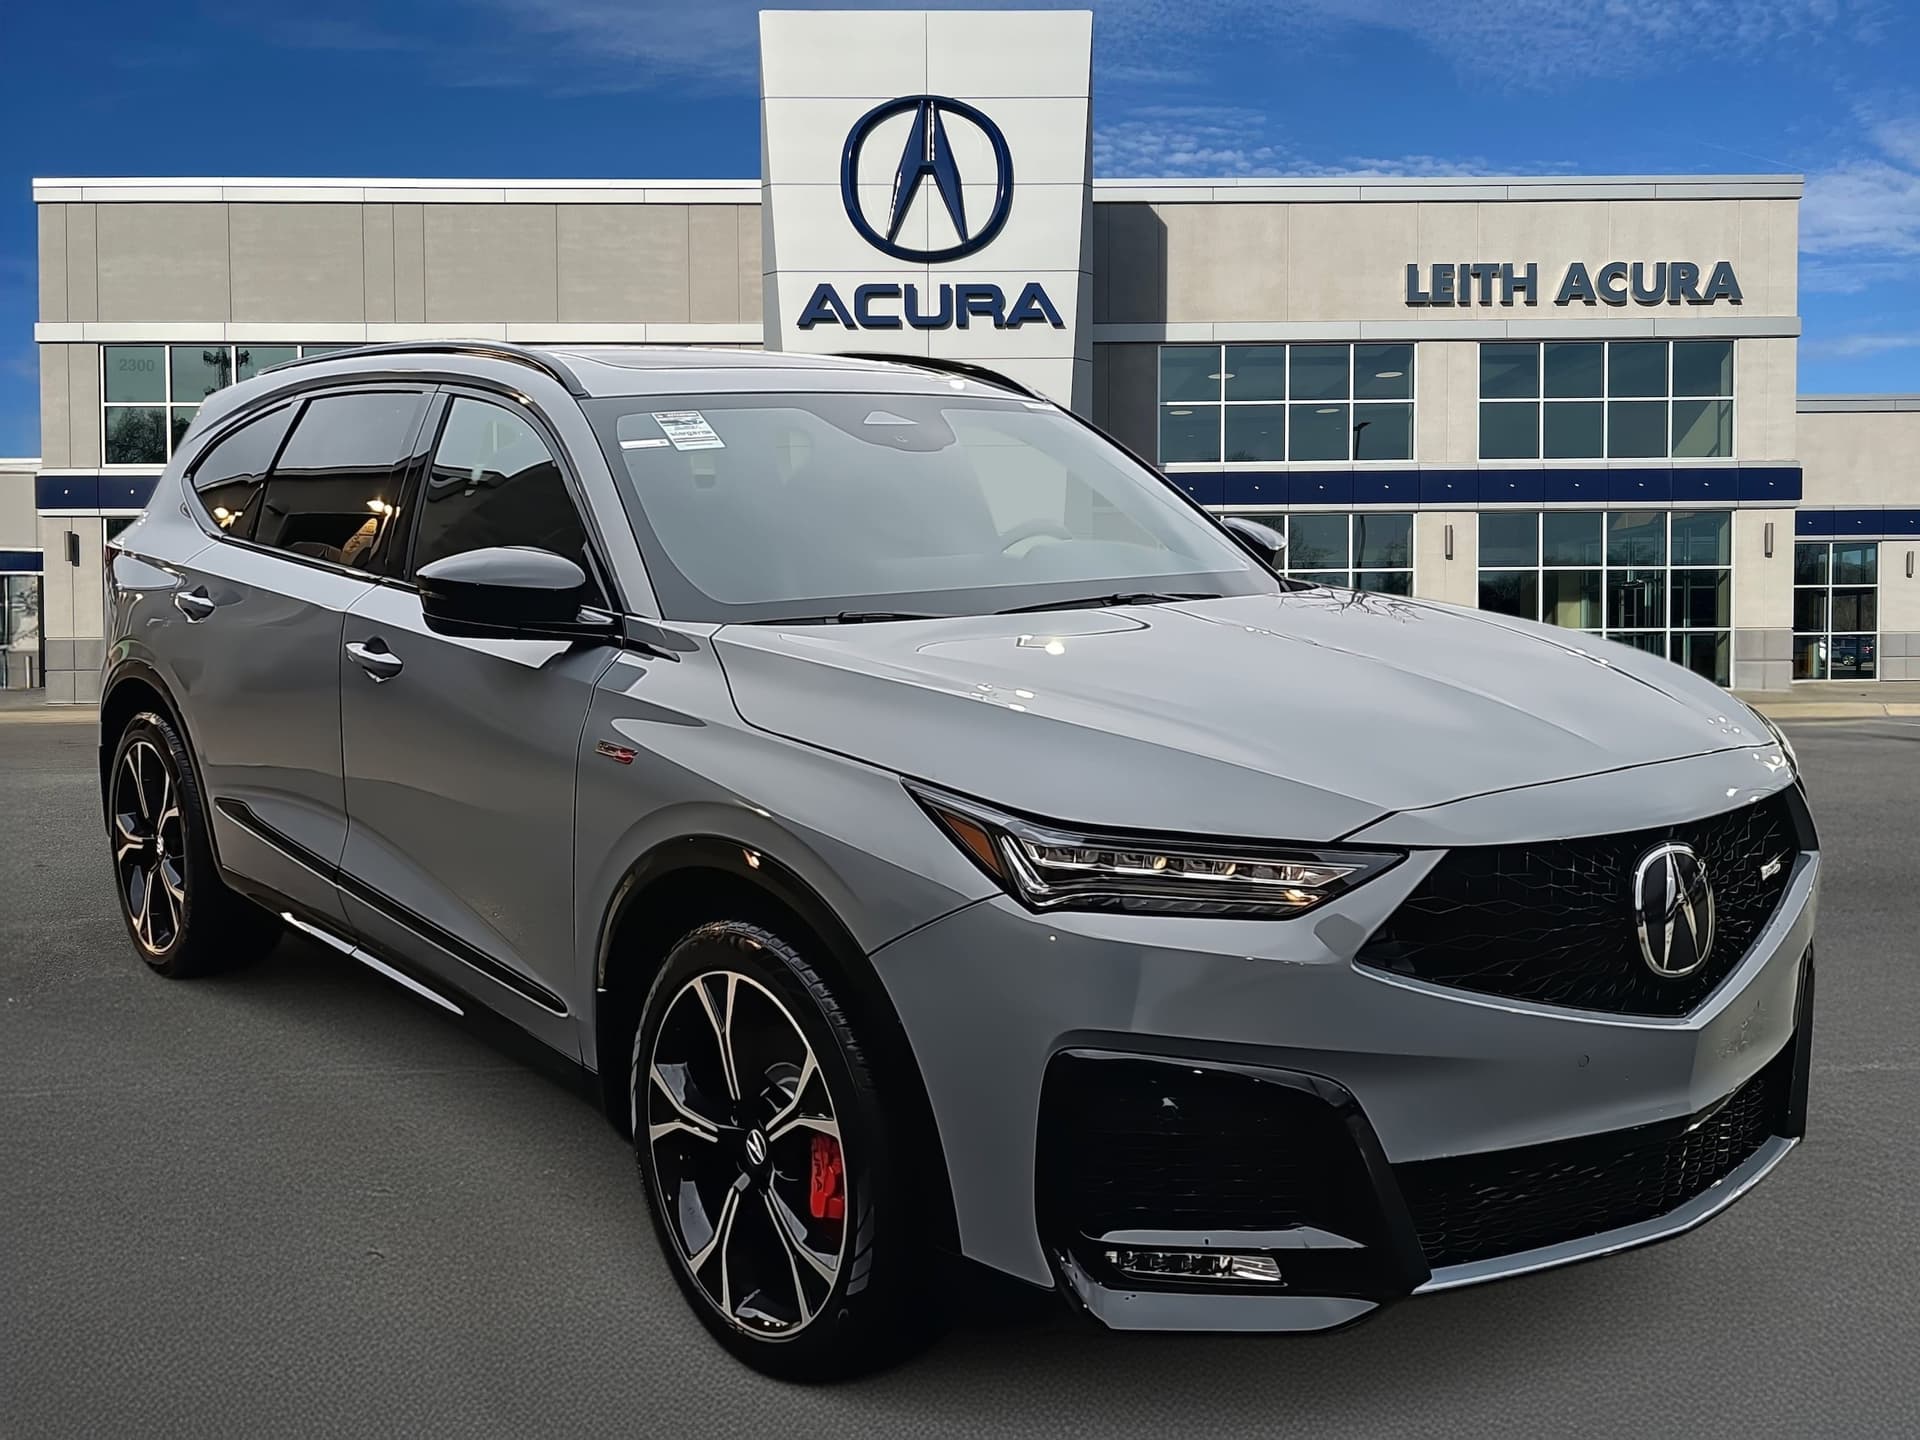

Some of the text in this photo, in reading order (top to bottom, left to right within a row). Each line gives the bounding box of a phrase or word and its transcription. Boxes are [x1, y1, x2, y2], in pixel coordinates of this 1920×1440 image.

[797, 283, 1066, 330] ACURA
[1405, 260, 1744, 307] LEITH ACURA
[119, 358, 154, 371] 2300
